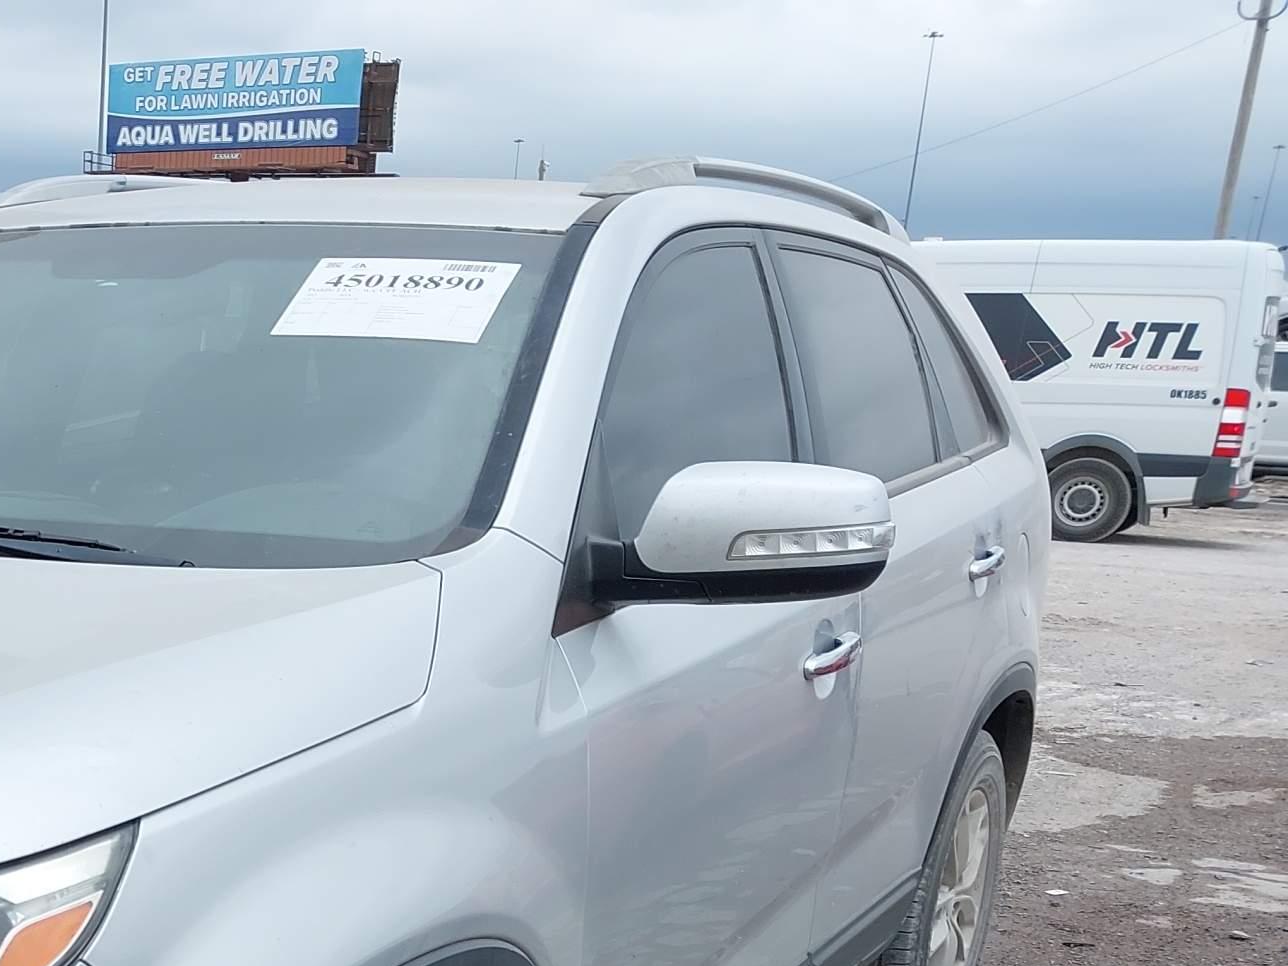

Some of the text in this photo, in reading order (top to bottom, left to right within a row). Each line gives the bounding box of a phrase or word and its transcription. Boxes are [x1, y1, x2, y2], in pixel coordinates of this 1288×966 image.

[124, 55, 339, 92] GET FREE WATER
[135, 87, 321, 112] FOR LAWN IRRIGATION
[116, 117, 339, 147] AQUA WELL DRILLING
[325, 273, 485, 292] 45018890
[1092, 321, 1203, 360] HTL
[1115, 362, 1139, 370] TECH
[1140, 363, 1200, 372] LOCKSMITHS
